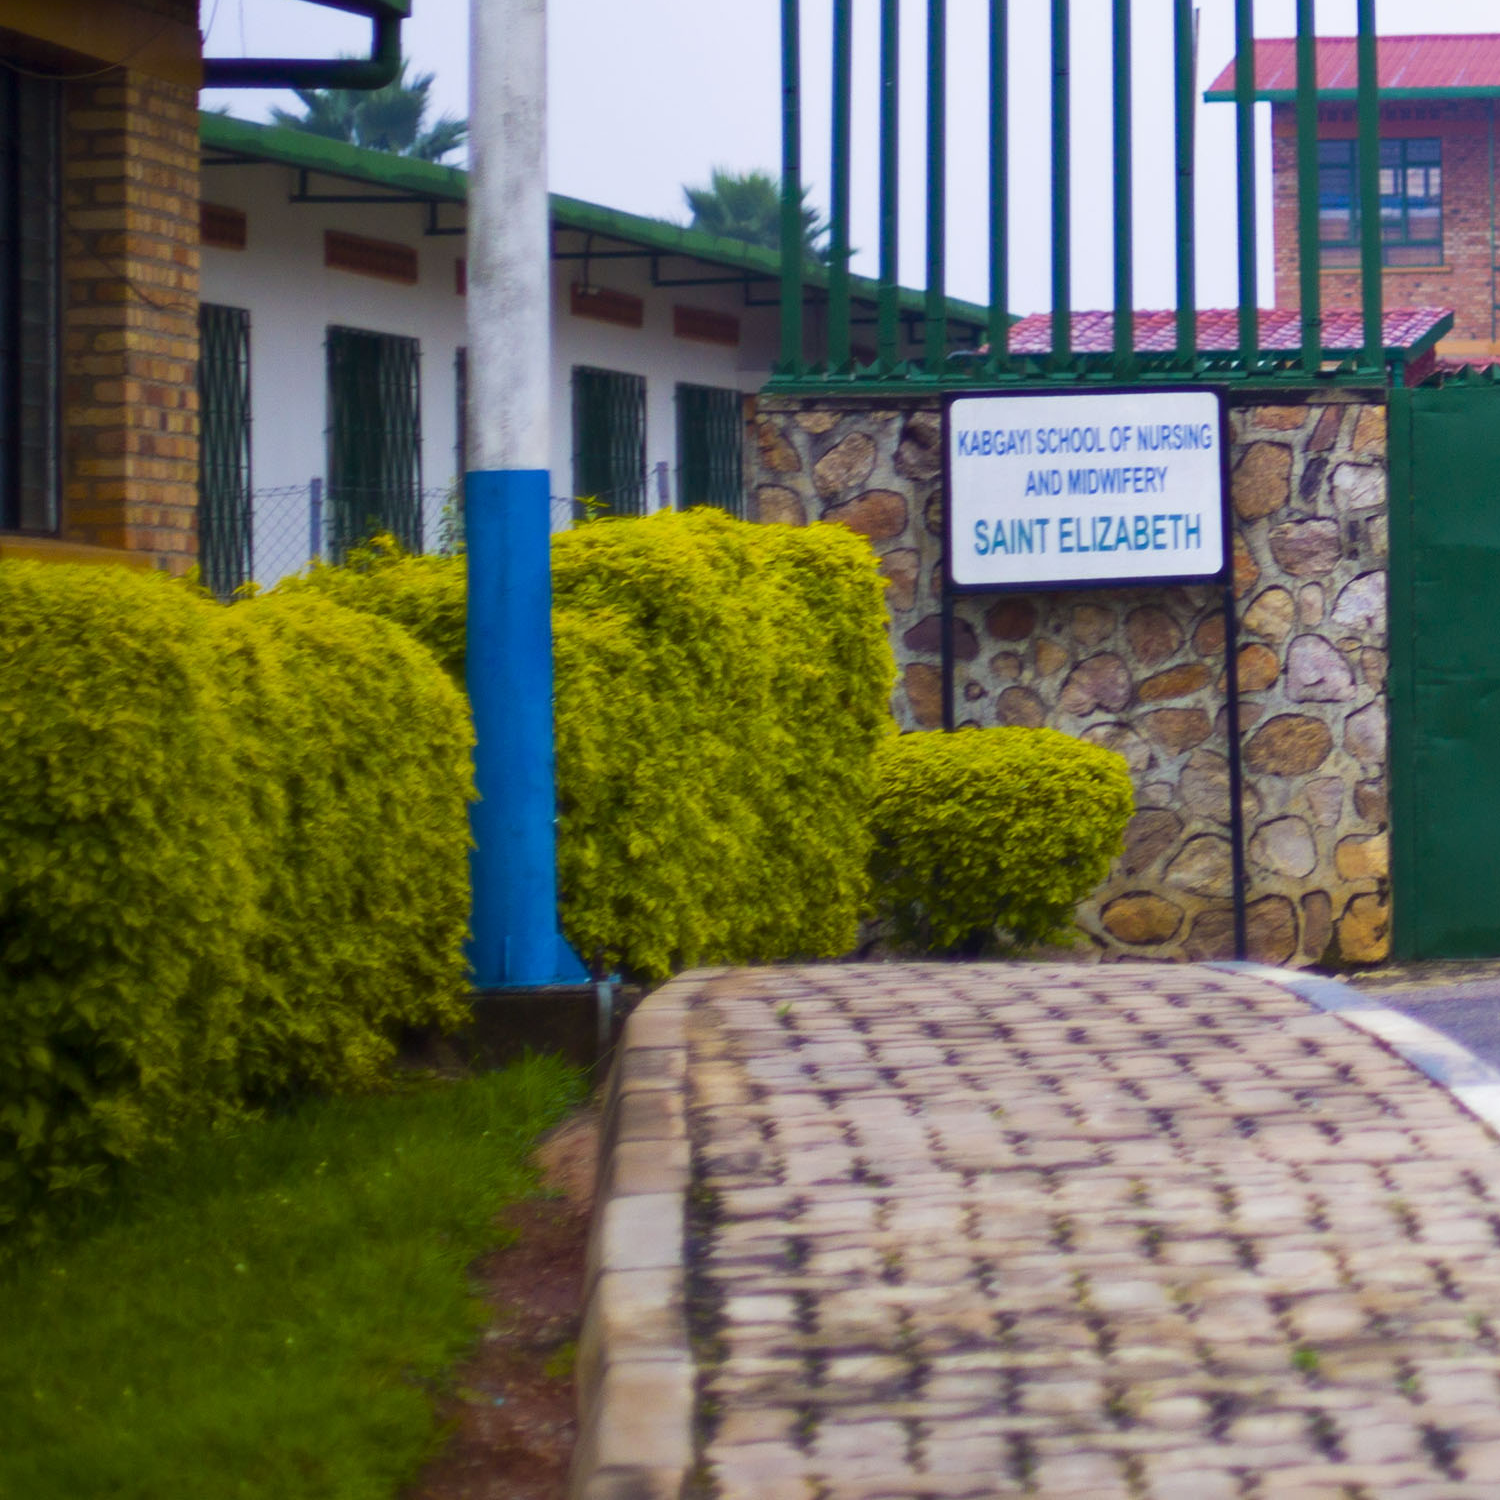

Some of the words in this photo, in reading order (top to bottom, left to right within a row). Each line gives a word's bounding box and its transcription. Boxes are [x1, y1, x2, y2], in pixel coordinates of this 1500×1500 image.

[957, 429, 1032, 456] KABGAYI
[1036, 427, 1105, 455] SCHOOL
[1109, 426, 1132, 453] OF
[1137, 423, 1212, 452] NURSING
[1025, 469, 1062, 497] AND
[1068, 466, 1168, 496] MIDWIFERY
[974, 517, 1049, 556] SAINT
[1059, 513, 1202, 554] ELIZABETH
